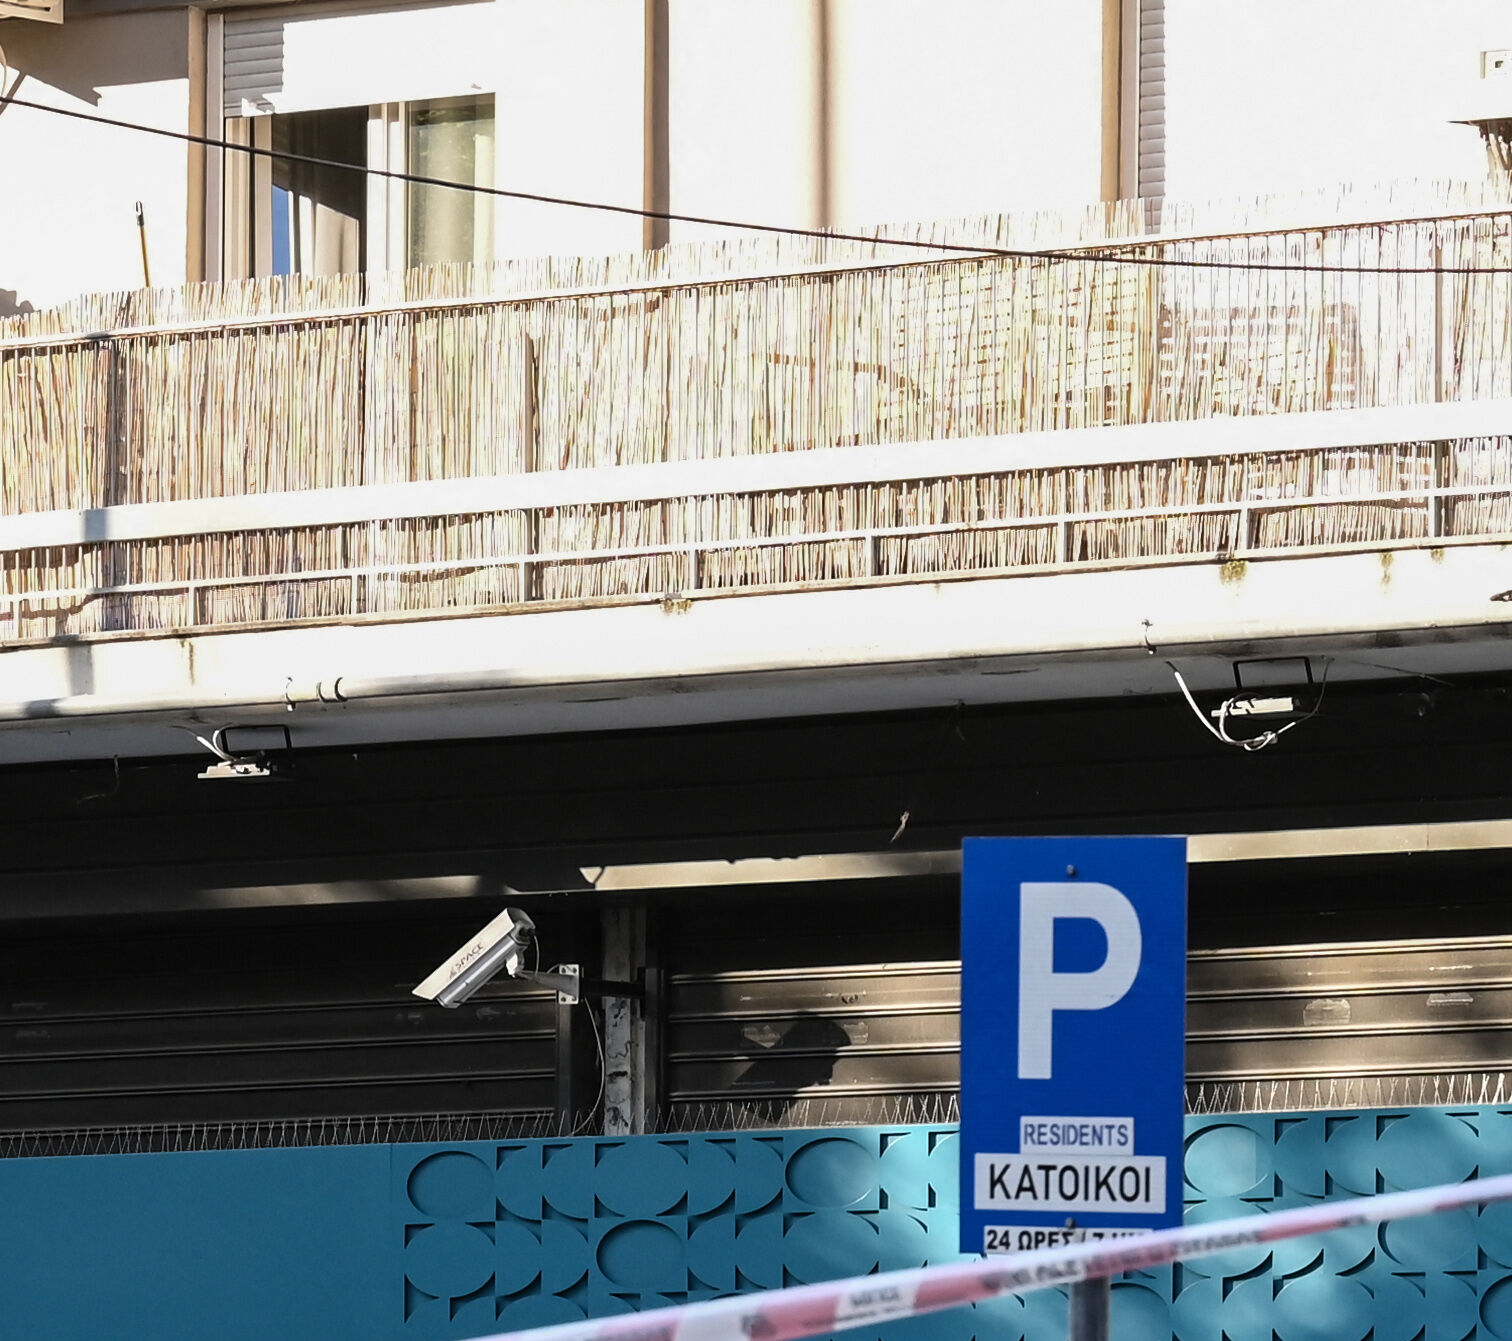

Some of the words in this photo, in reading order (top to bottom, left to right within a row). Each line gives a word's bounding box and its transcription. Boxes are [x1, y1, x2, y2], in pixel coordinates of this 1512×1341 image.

[1017, 882, 1142, 1079] P
[1023, 1124, 1128, 1147] RESIDENTS
[988, 1163, 1151, 1203] ΚΑΤΟΙΚΟΙ
[986, 1229, 1011, 1251] 24
